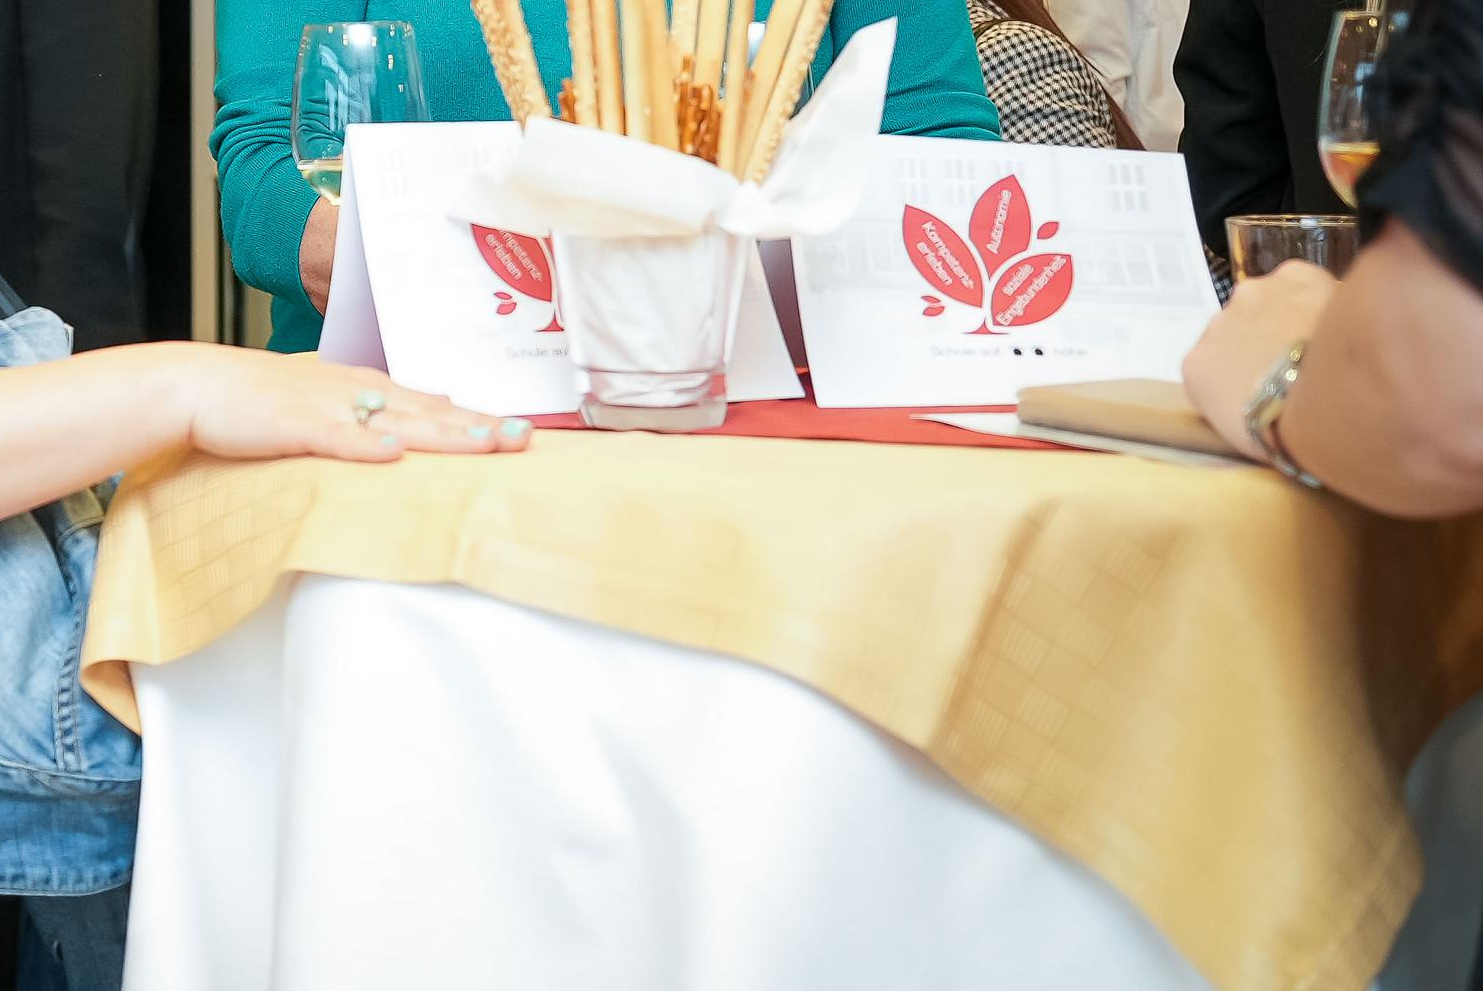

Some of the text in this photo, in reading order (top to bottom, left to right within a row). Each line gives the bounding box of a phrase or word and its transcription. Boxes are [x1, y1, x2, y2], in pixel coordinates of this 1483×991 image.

[985, 189, 1012, 255] Autonomie
[485, 233, 522, 280] erleben
[916, 241, 953, 286] erleben
[921, 220, 975, 289] Kompetenz
